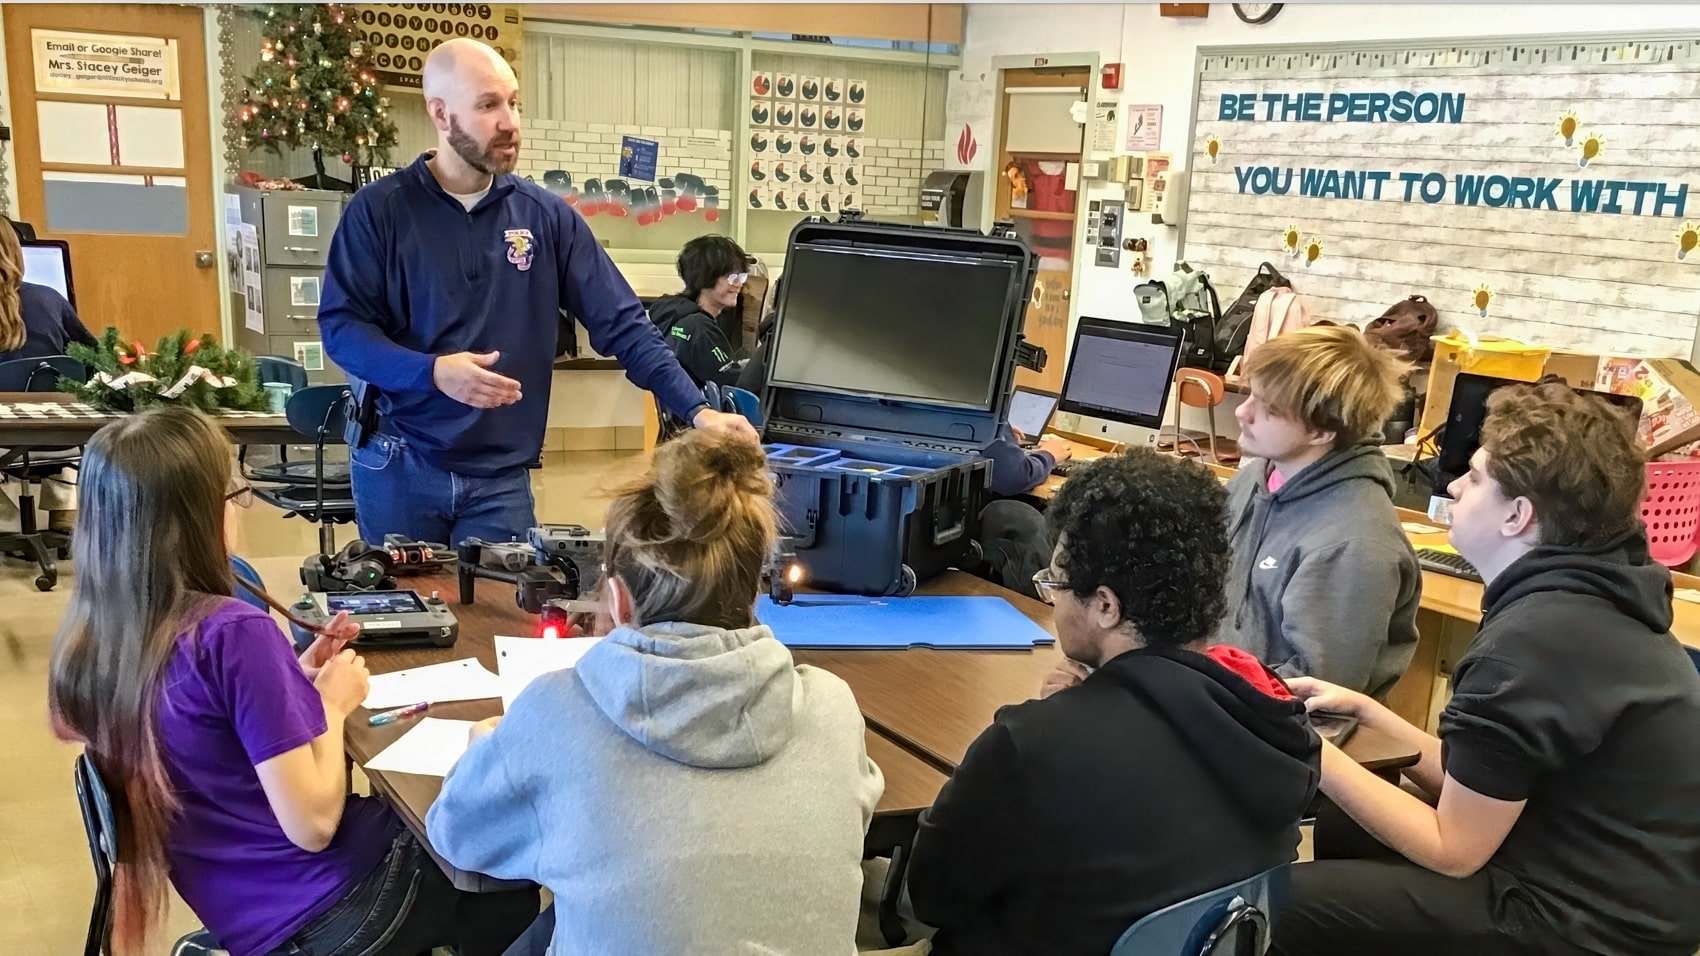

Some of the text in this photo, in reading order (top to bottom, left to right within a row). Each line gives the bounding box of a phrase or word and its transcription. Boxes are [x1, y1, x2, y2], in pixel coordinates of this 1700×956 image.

[46, 41, 75, 52] Email
[91, 44, 128, 56] Google
[130, 47, 162, 58] Share!
[48, 59, 162, 76] Mrs. Stacey Geiger
[1218, 91, 1465, 123] BE THE PERSON
[1234, 166, 1689, 217] YOU WANT TO WORK WITH
